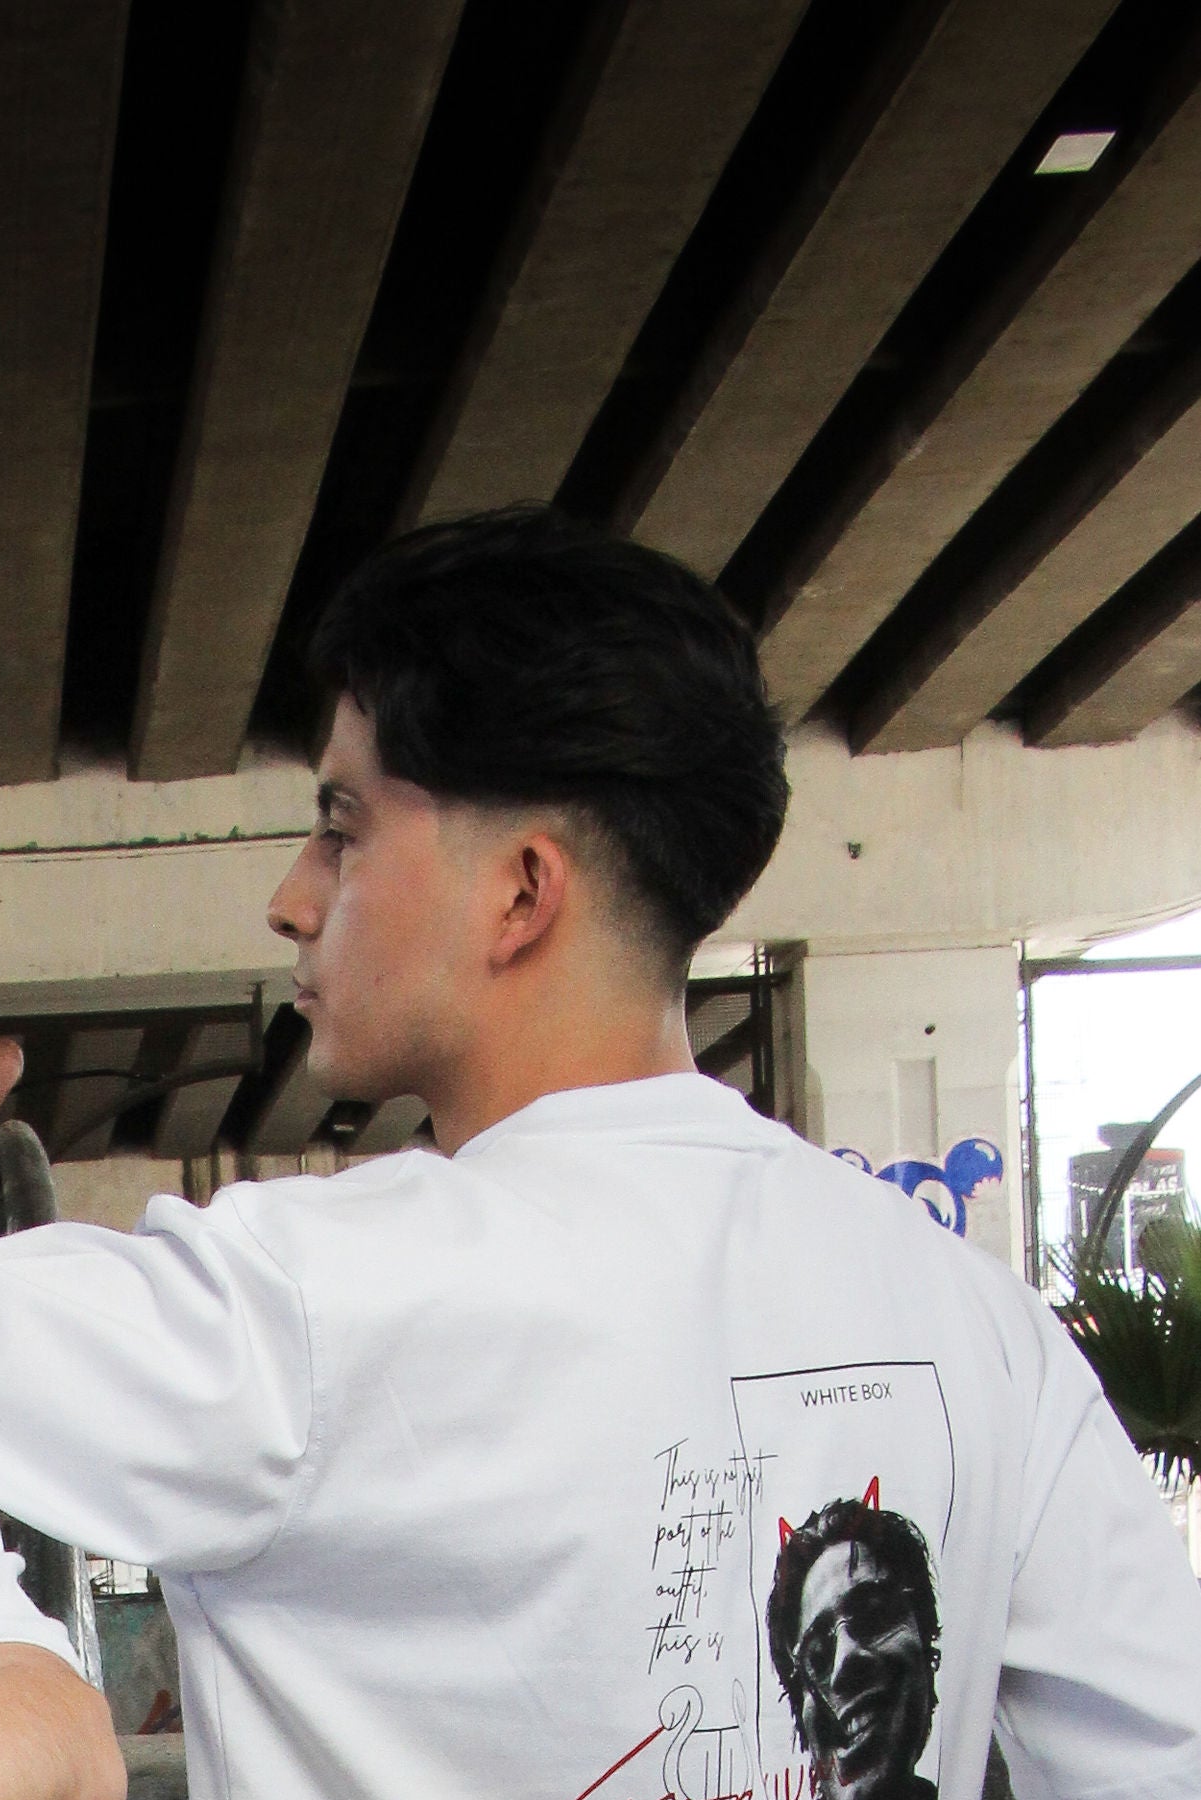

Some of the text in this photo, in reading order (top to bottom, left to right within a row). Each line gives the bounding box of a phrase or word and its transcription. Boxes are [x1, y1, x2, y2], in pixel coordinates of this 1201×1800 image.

[800, 1382, 893, 1407] WHITE BOX
[654, 1438, 700, 1511] This
[704, 1468, 720, 1499] is
[653, 1505, 697, 1571] part
[707, 1631, 724, 1662] is
